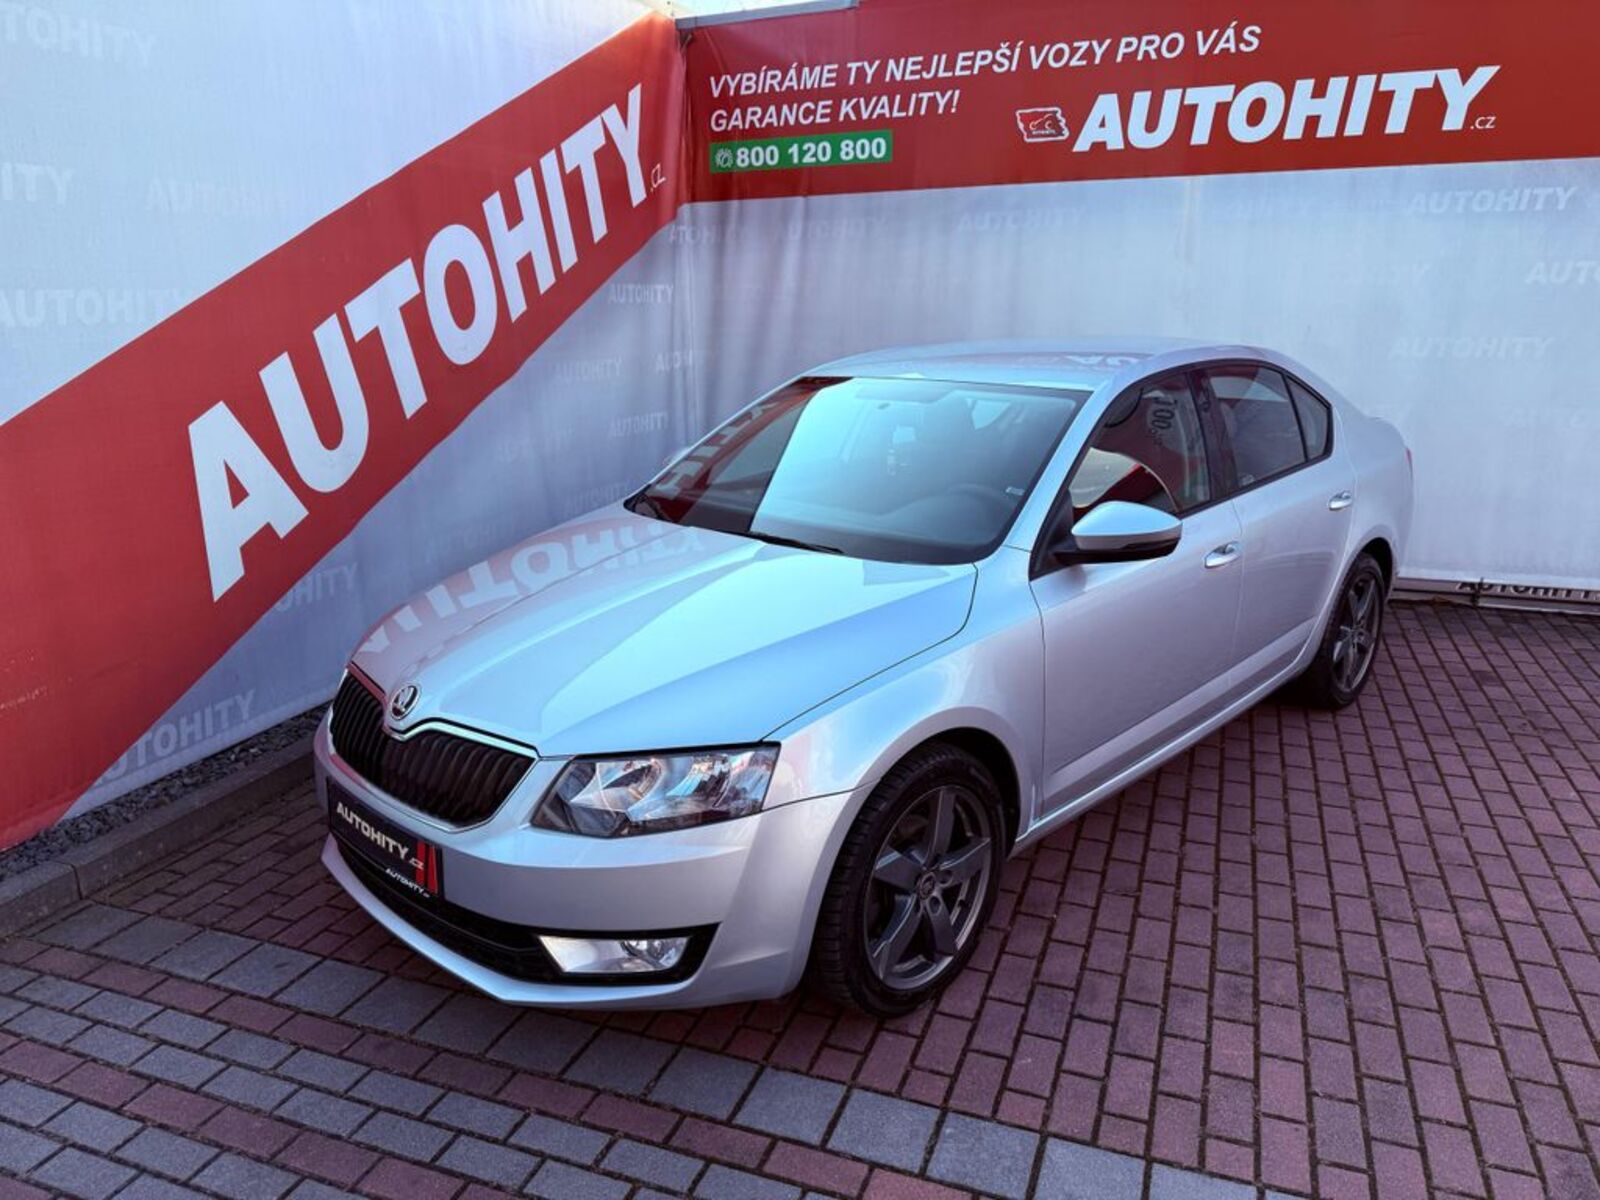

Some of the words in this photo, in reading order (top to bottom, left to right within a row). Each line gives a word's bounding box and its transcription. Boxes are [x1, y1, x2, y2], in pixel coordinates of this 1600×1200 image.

[709, 62, 838, 98] VYBÍRÁME
[846, 60, 881, 86] TY
[885, 41, 1024, 83] NEJLEPŠÍ
[1030, 38, 1111, 70] VOZY
[1116, 32, 1185, 63] PRO
[1196, 20, 1261, 56] VÁS
[710, 100, 833, 132] GARANCE
[839, 90, 961, 122] KVALITY!
[736, 146, 779, 168] 800
[788, 142, 832, 164] 120
[840, 137, 887, 160] 800
[1405, 185, 1578, 216] AUTOHITY
[336, 801, 409, 860] AUTOHITY
